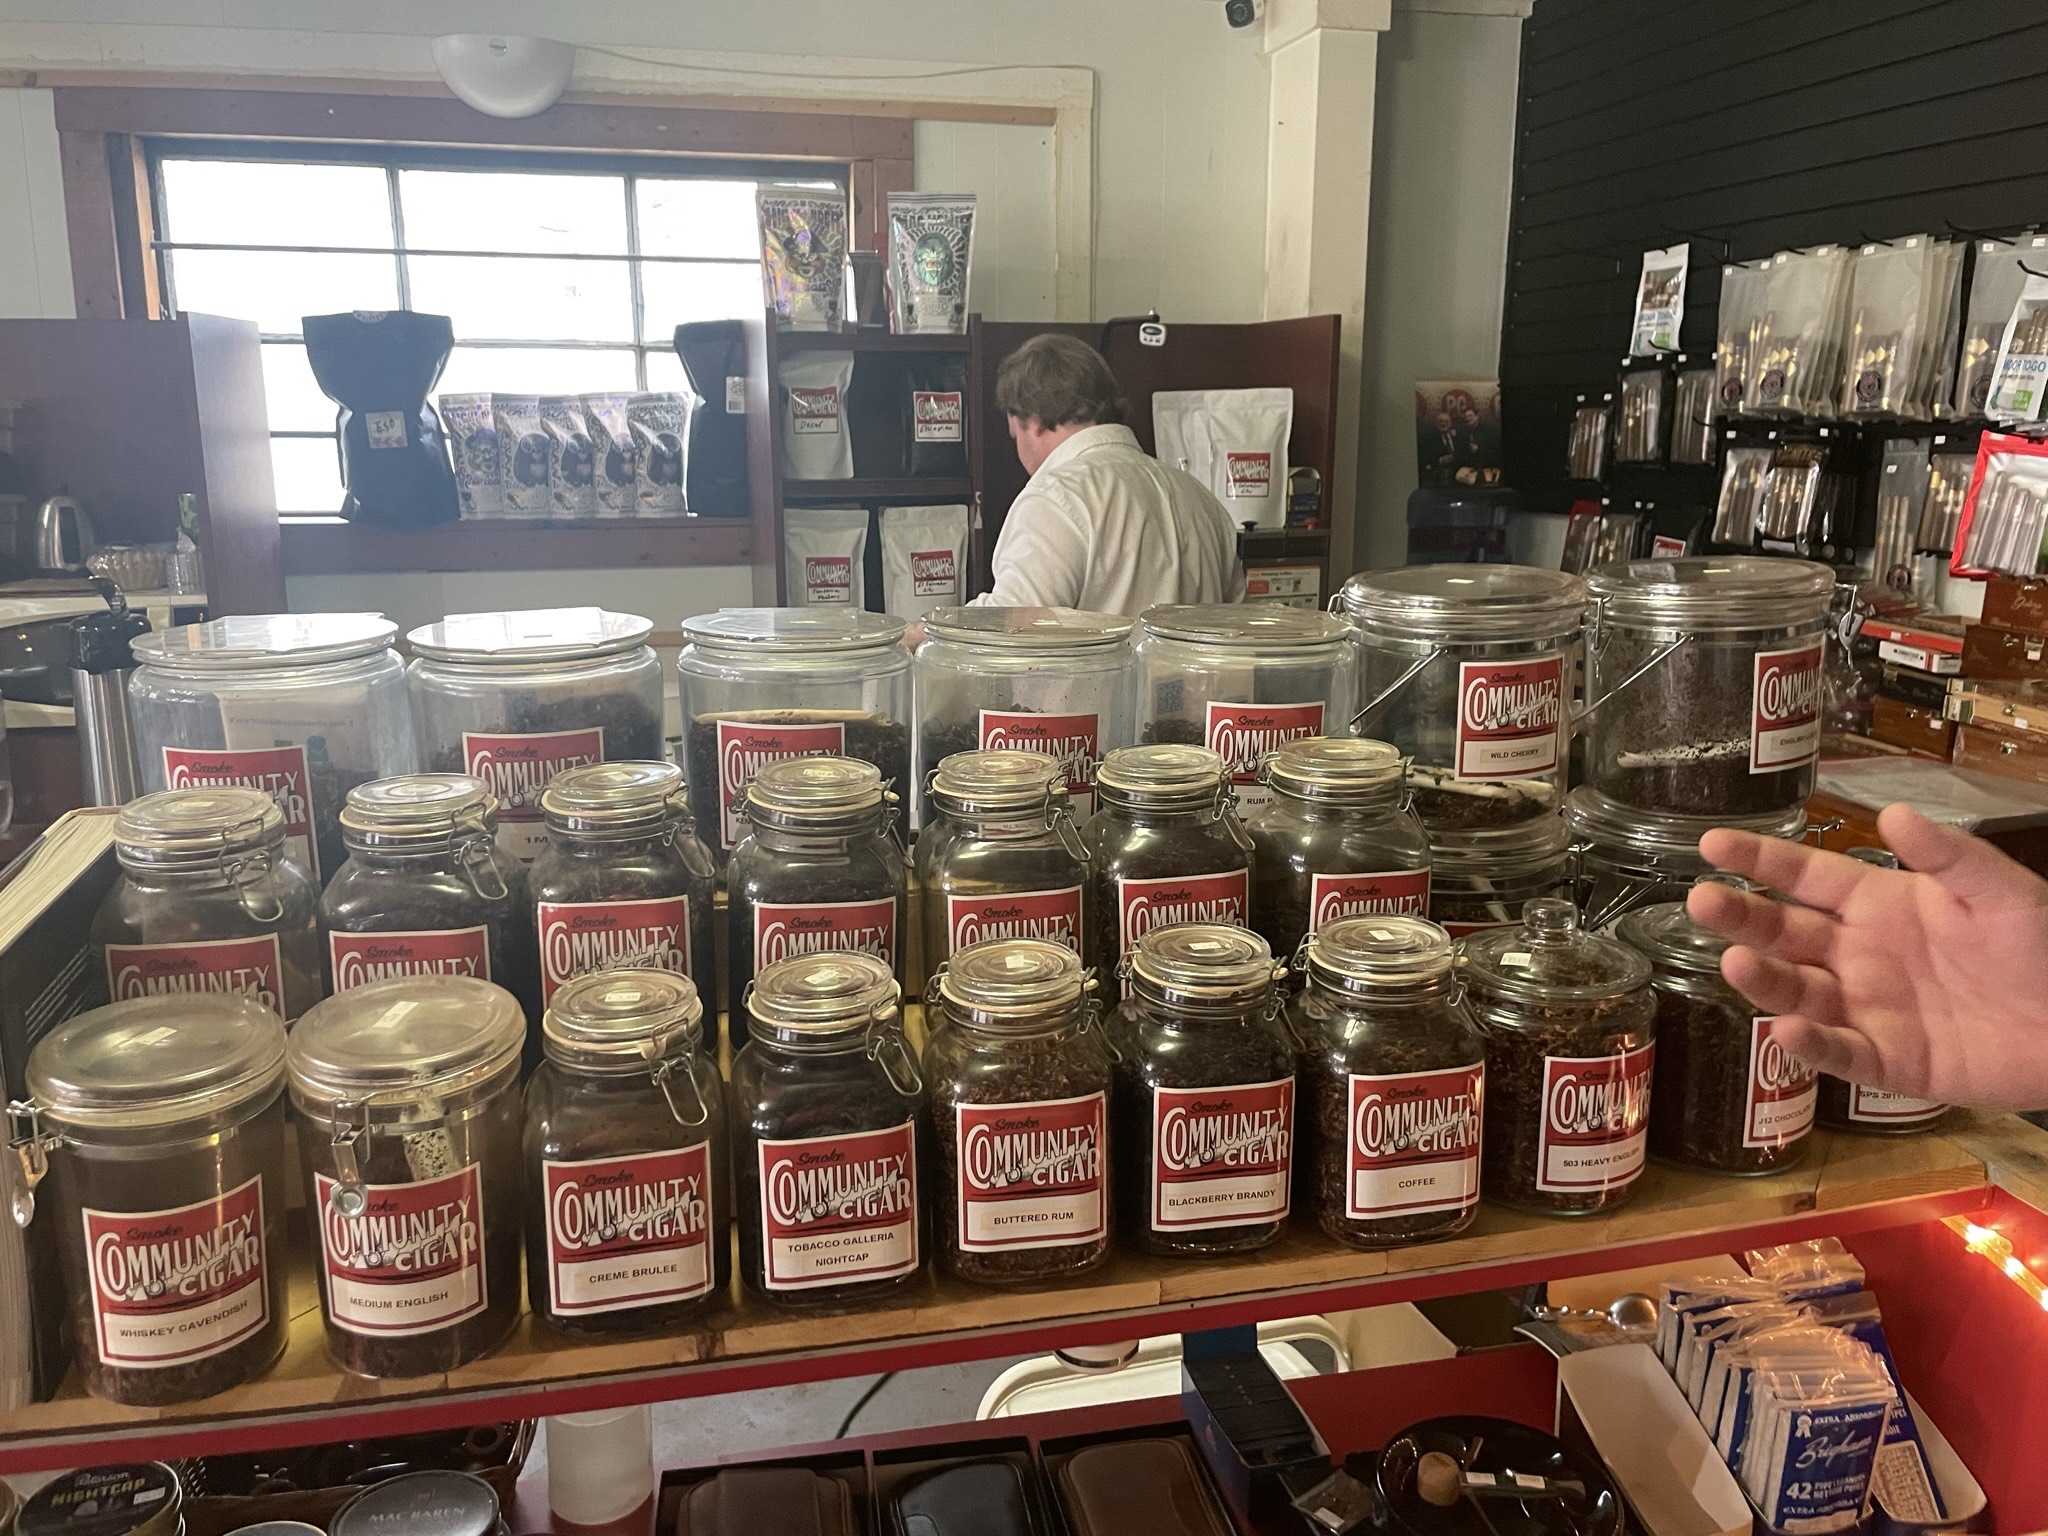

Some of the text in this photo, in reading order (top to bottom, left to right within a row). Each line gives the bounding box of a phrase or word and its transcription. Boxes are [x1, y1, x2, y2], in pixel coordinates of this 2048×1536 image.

[1464, 677, 1559, 731] COMMUNITY
[1516, 697, 1559, 729] CIGAR
[1008, 724, 1048, 736] Smoke
[1236, 715, 1275, 727] Smoke
[744, 736, 783, 748] Smoke
[494, 746, 538, 758] Smoke
[1490, 748, 1539, 759] WILD CHERRY
[192, 760, 234, 774] Smoke
[1151, 888, 1192, 902] Smoke
[1343, 884, 1382, 897] Smoke
[570, 914, 616, 928] Smoke
[980, 905, 1023, 920] Smoke
[788, 916, 833, 928] Smoke
[546, 920, 680, 985] COMMUNITY
[992, 1116, 1040, 1131] Smoke
[1356, 1092, 1478, 1158] COMMUNITY
[1759, 1116, 1773, 1124] J12
[1161, 1105, 1288, 1171] COMMUNITY
[1418, 1115, 1480, 1152] CIGAR
[797, 1148, 845, 1166] Smoke
[964, 1122, 1099, 1190] COMMUNITY
[1224, 1130, 1290, 1166] CIGAR
[1032, 1148, 1101, 1186] CIGAR
[1581, 1157, 1610, 1167] HEAVY
[768, 1152, 907, 1226] COMMUNITY
[1398, 1176, 1436, 1188] COFFEE
[838, 1178, 912, 1220] CIGAR
[1168, 1189, 1276, 1207] BLACKBERRY BRANDY
[553, 1172, 702, 1250] COMMUNITY
[994, 1212, 1074, 1225] BUTTERED RUM
[628, 1199, 707, 1242] CIGAR
[325, 1195, 471, 1267] COMMUNITY
[394, 1220, 478, 1272] CIGAR
[788, 1232, 894, 1253] TOBACCO GALLERIA
[96, 1208, 254, 1302] COMMUNITY
[816, 1252, 869, 1267] NIGHTCAP
[178, 1236, 260, 1296] CIGAR
[590, 1264, 678, 1284] CREME BRULEE
[350, 1291, 448, 1308] MEDIUM ENGLISH
[120, 1300, 248, 1338] WHISKEY CAVENDISH
[52, 1478, 146, 1505] NIGHTCAP
[1786, 1482, 1812, 1500] 42
[369, 1513, 402, 1522] MAC
